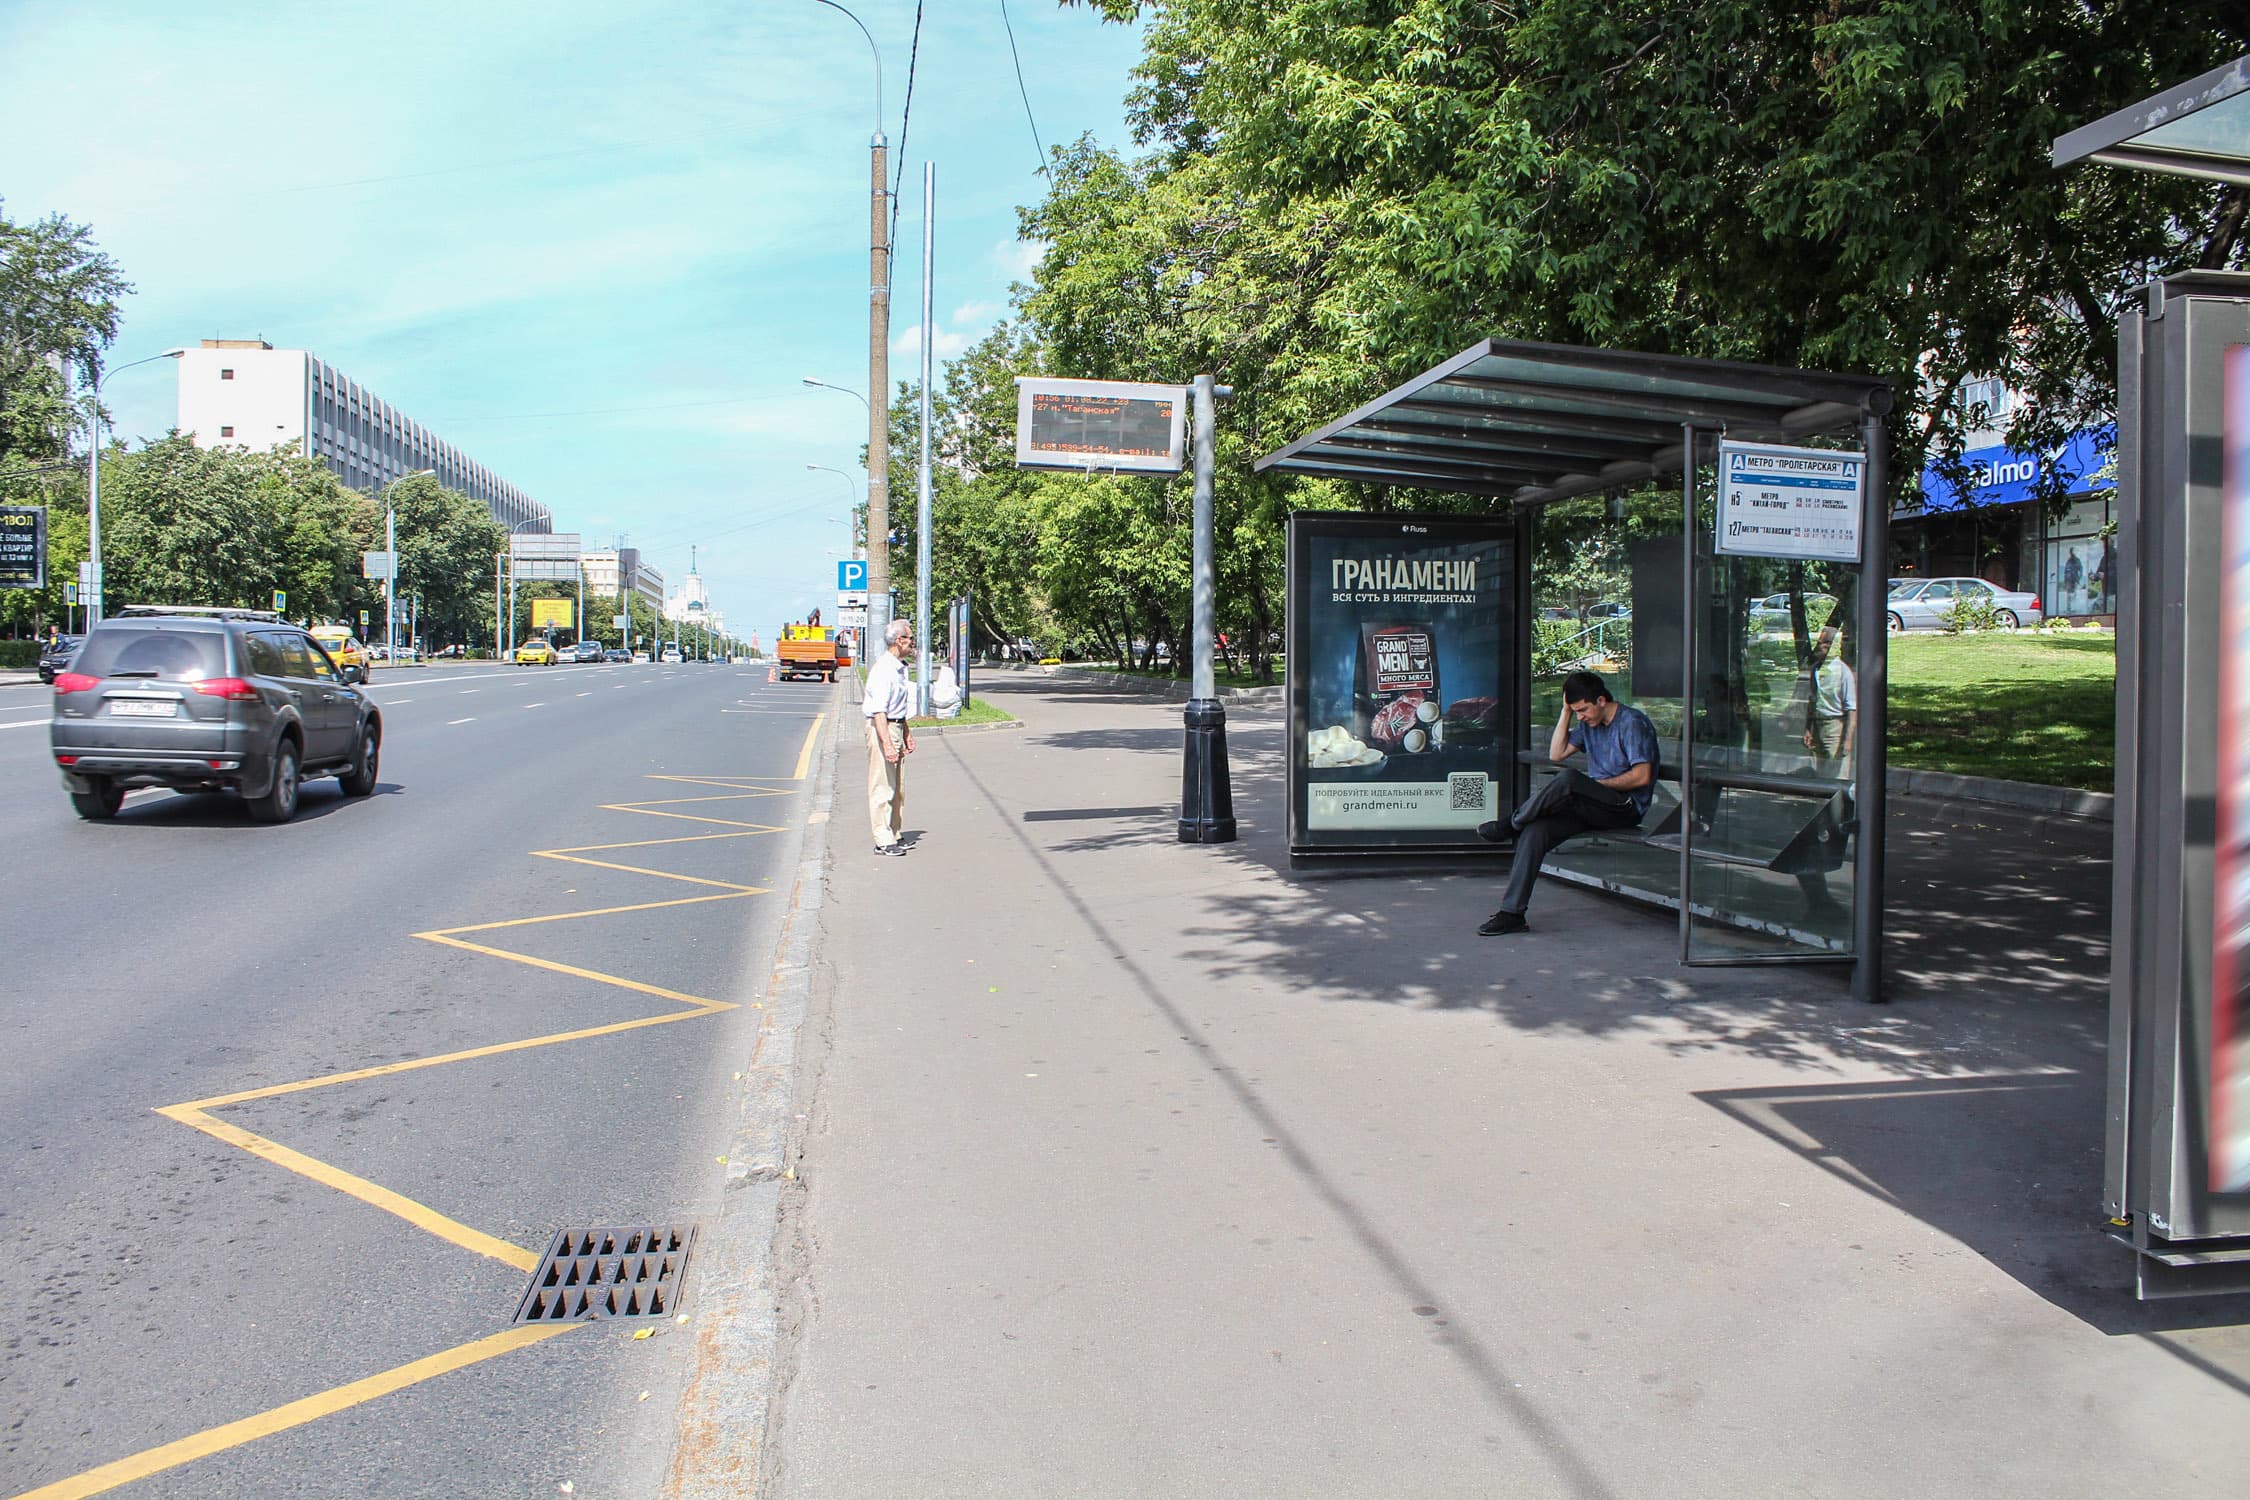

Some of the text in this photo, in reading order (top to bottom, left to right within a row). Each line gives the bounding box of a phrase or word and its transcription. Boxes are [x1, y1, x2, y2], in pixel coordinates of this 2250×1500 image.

[1747, 457, 1774, 467] МЕТРО
[1775, 459, 1841, 472] "ПРОЛЕТАРСКАЯ"
[1760, 492, 1779, 500] МЕТРО
[845, 564, 863, 588] P
[1332, 559, 1476, 591] ГРАНДМЕНИ
[1332, 593, 1476, 604] ВСЯ СУТЬ В ИНГРЕДИЕНТАХ!
[1376, 640, 1408, 653] GRAND
[1378, 653, 1410, 673] MENI
[1380, 675, 1407, 683] МНОГО
[1315, 789, 1369, 797] ПОПРОБУЙТЕ
[1370, 788, 1422, 797] ИДЕАЛЬНЫЙ
[1342, 800, 1418, 812] grandmeni.ru
